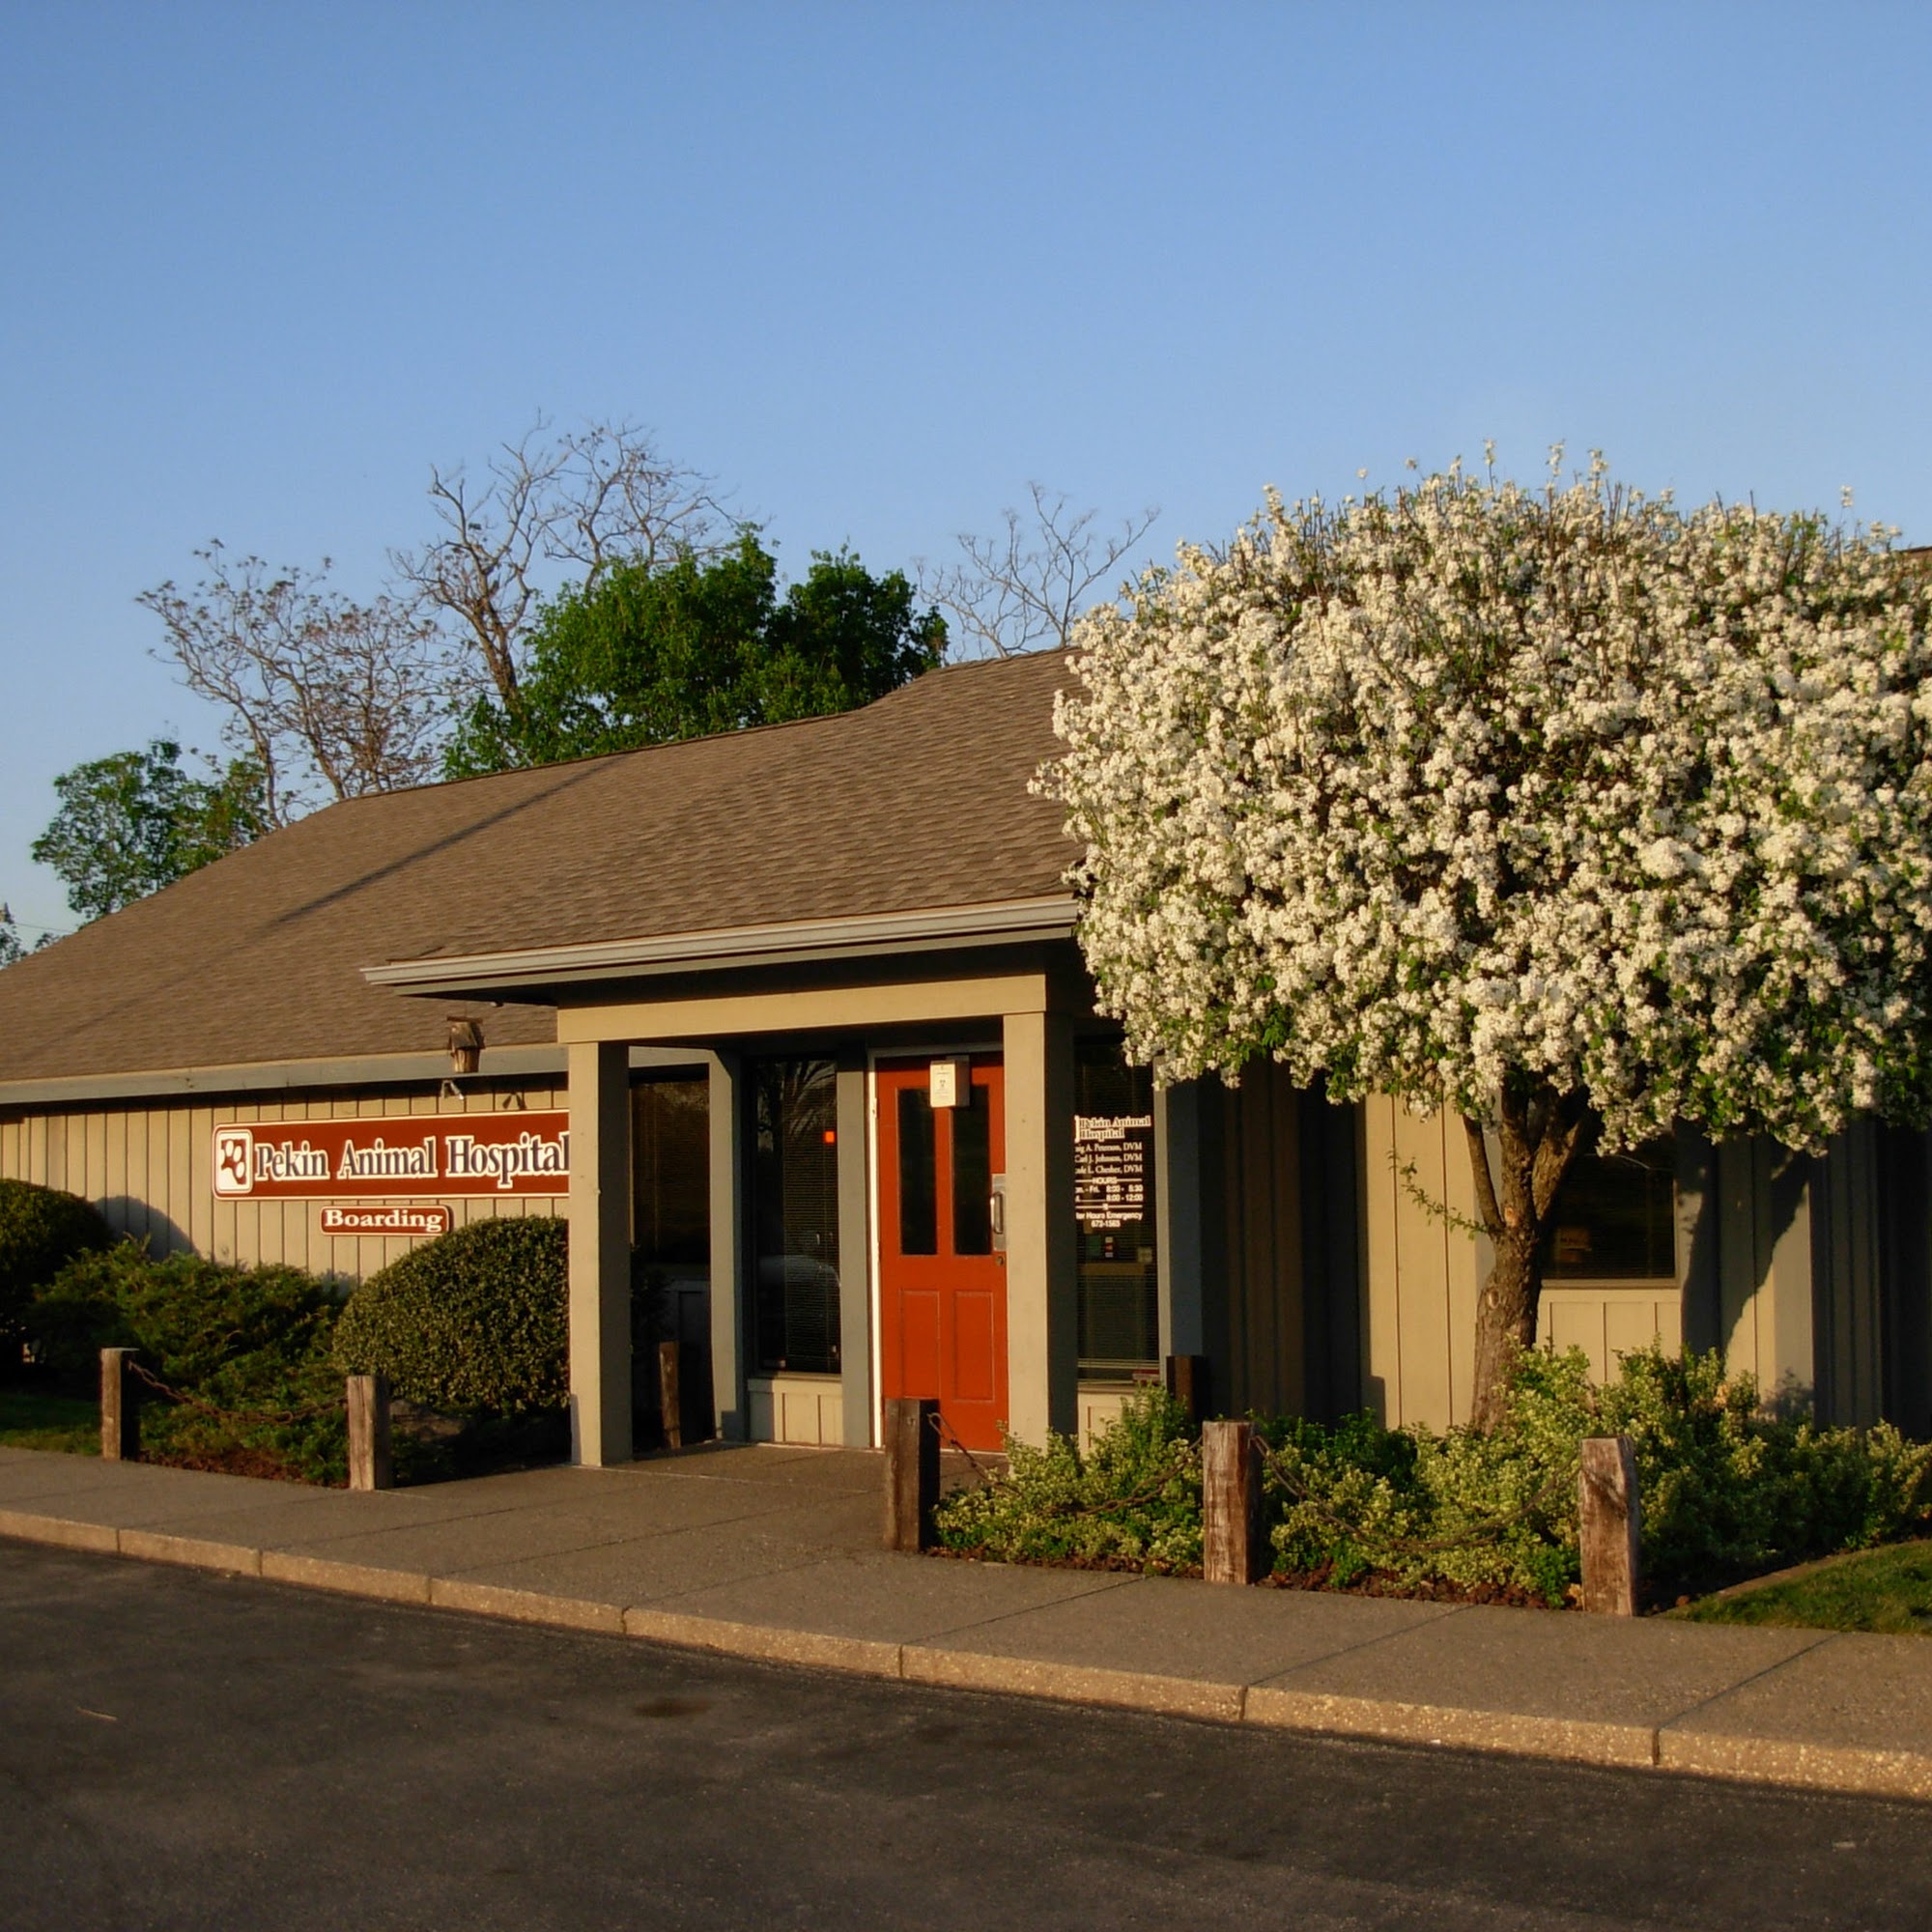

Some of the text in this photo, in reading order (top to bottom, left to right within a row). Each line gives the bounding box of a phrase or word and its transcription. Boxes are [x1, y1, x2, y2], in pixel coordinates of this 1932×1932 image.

[1113, 1115, 1151, 1127] Animal
[1080, 1127, 1125, 1142] Hospital
[1123, 1142, 1143, 1151] DVM
[255, 1130, 570, 1189] Pekin Animal Hospital
[1123, 1153, 1143, 1162] DVM
[1123, 1164, 1143, 1173] DVM
[324, 1208, 443, 1233] Boarding
[1106, 1211, 1143, 1221] Emergency
